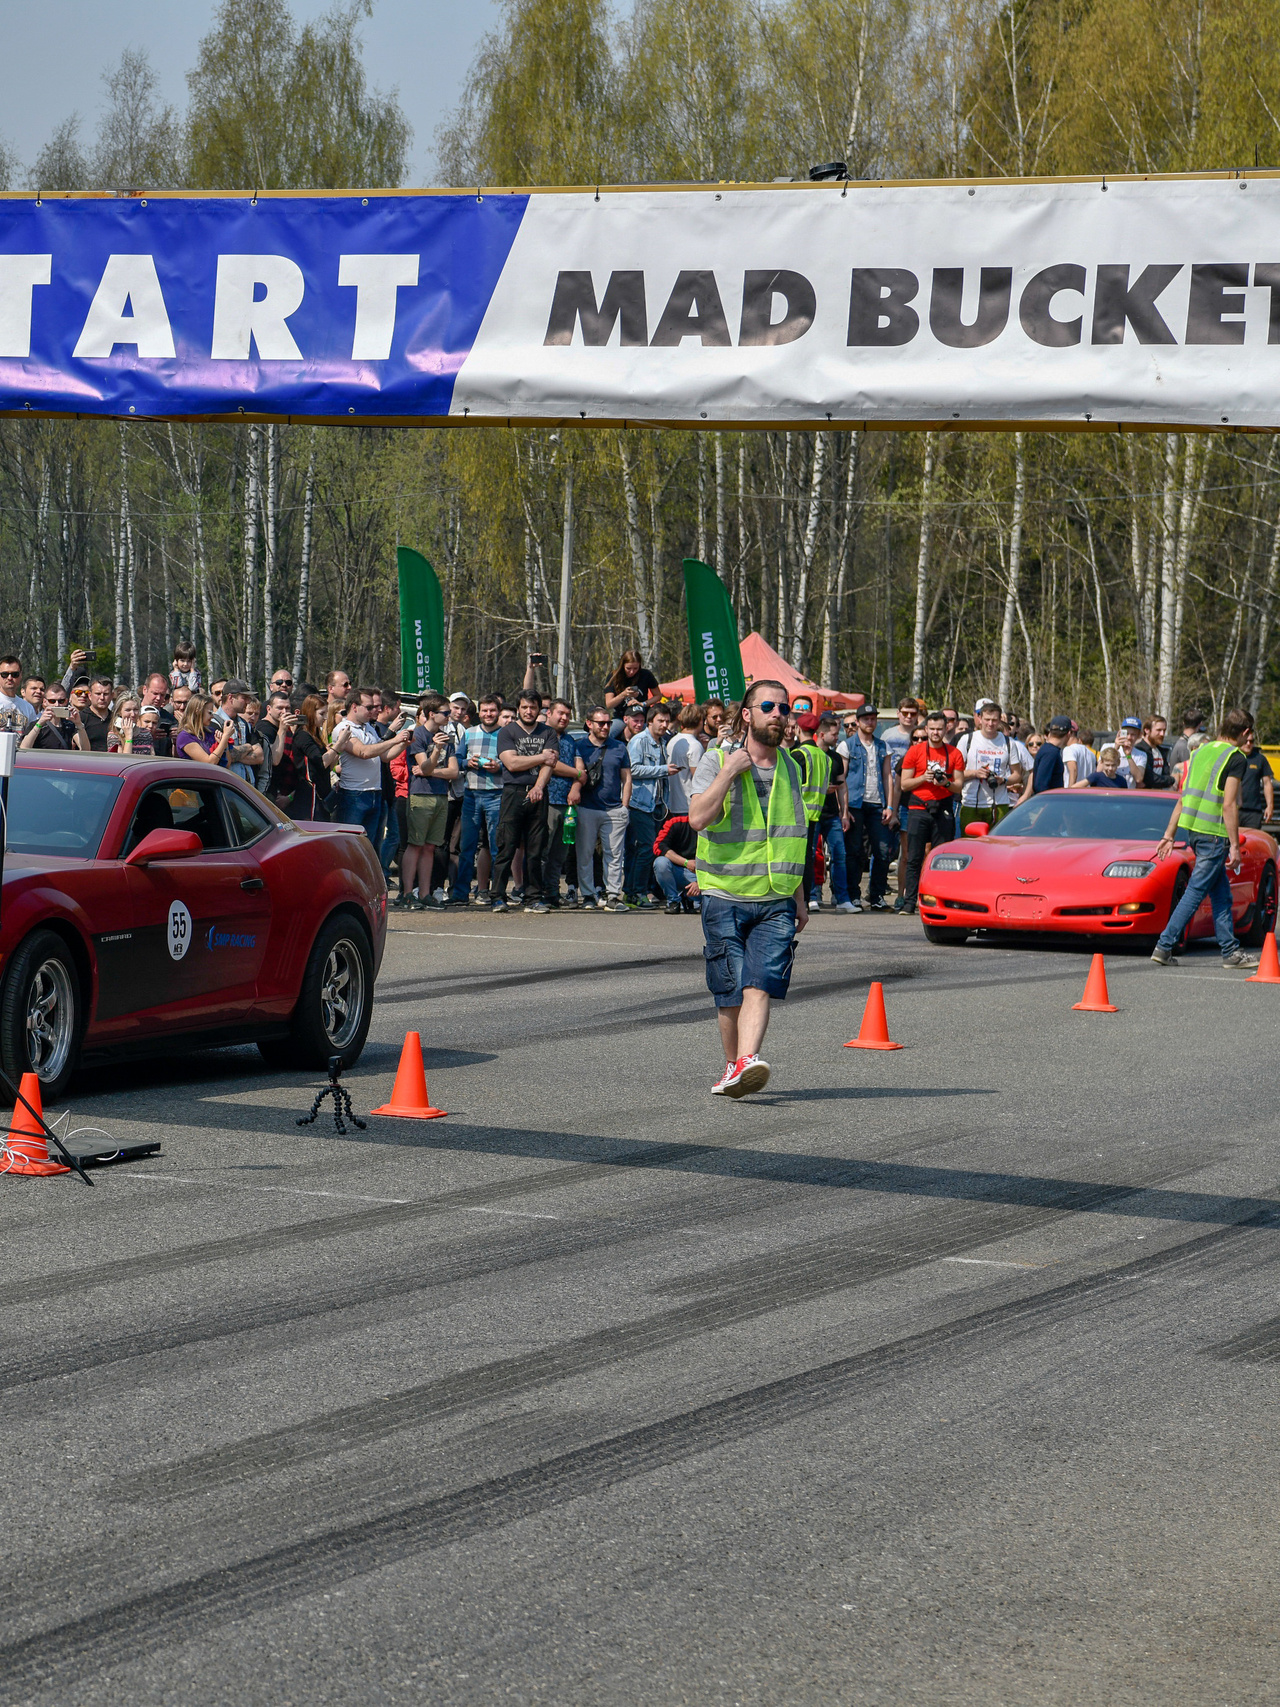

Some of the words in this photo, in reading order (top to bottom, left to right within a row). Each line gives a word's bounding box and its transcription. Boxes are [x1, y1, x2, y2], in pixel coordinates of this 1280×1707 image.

[543, 270, 817, 347] MAD
[414, 619, 425, 696] EEDOM
[172, 912, 187, 939] 55
[214, 933, 230, 946] SMP
[230, 934, 256, 948] RACING
